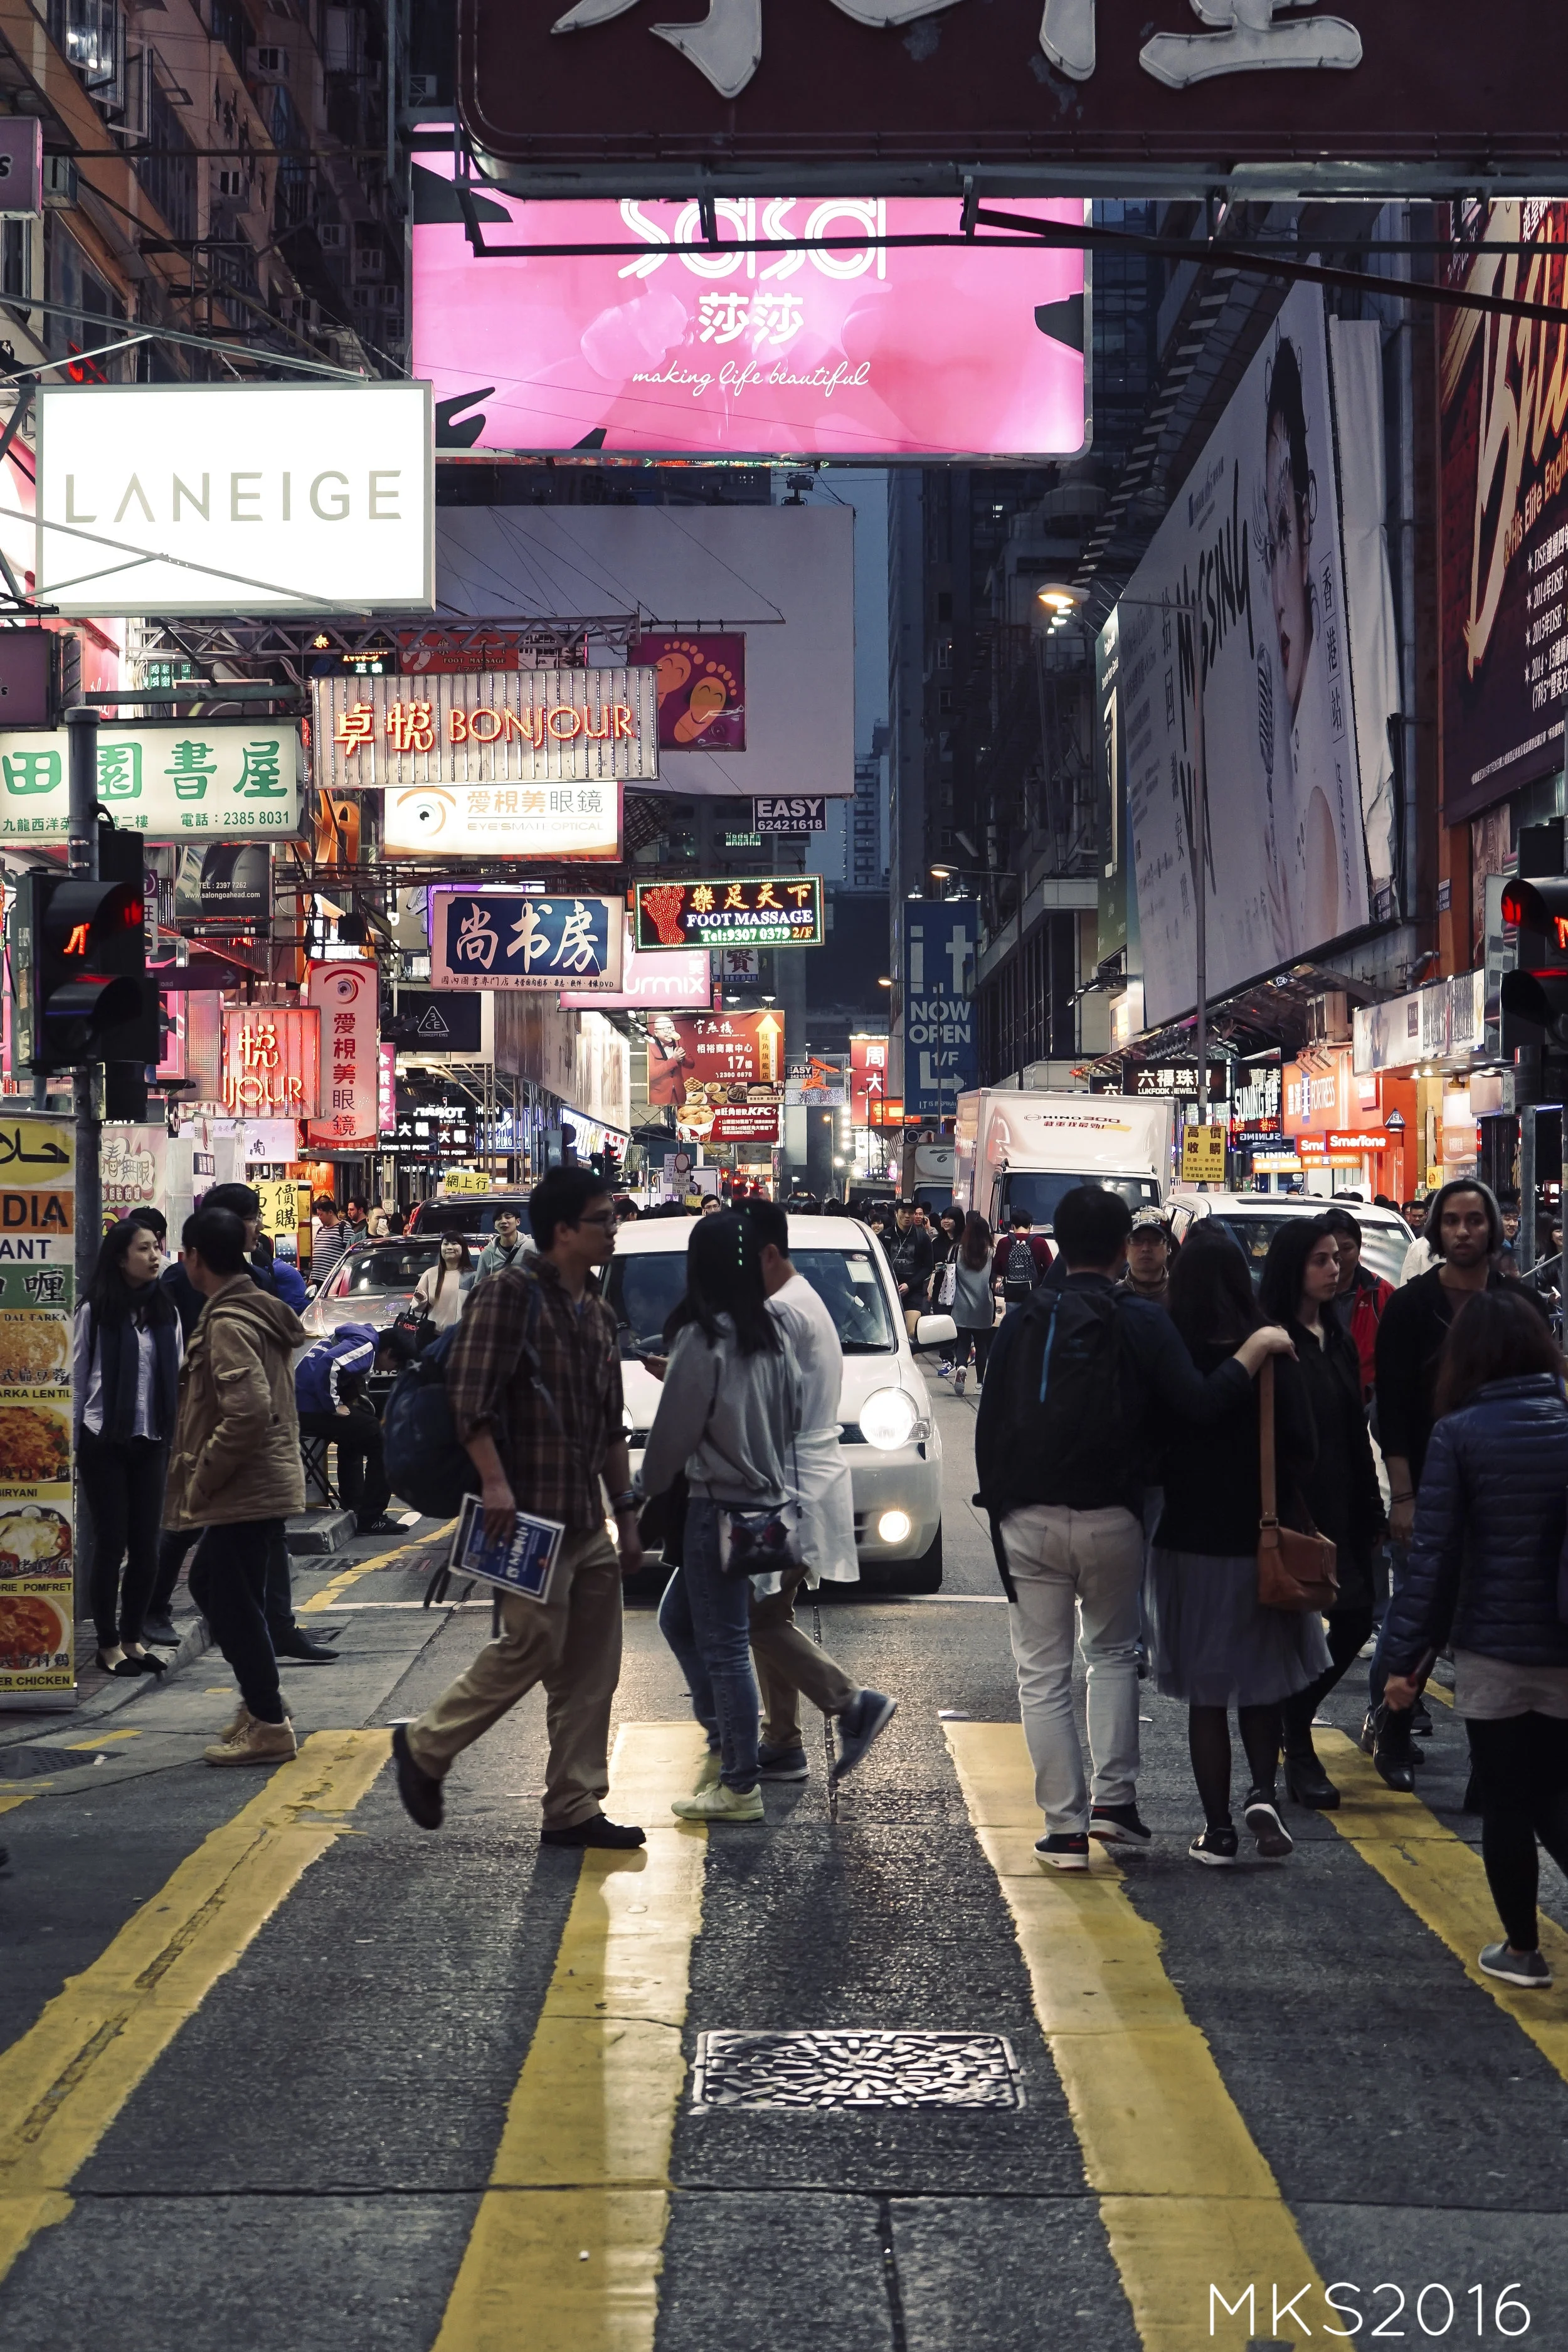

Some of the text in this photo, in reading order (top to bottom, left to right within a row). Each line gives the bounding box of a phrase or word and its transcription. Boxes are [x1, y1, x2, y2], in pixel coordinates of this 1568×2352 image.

[698, 292, 803, 345] 莎莎
[632, 360, 872, 398] making life beautiful
[65, 469, 403, 524] LANEIGE
[1525, 481, 1543, 534] Elite
[1322, 564, 1344, 733] 香港站
[448, 703, 635, 747] BONJOUR
[1, 739, 288, 800] 田園書屋
[467, 790, 603, 813] 愛視美眼鏡
[757, 798, 823, 817] EASY
[758, 819, 823, 830] 62421618
[185, 891, 261, 899] www.salongoahead.com
[690, 882, 812, 913] 樂足天下
[686, 909, 813, 927] FOOT MASSAGE
[760, 927, 791, 940] 0379
[792, 926, 813, 938] 2/F
[910, 1001, 972, 1022] NOW
[909, 1024, 971, 1044] OPEN
[332, 1012, 356, 1136] 愛視美眼鏡
[1234, 1084, 1264, 1121] SUNING
[1311, 1076, 1335, 1110] FORTRESS
[1330, 1135, 1386, 1147] SmarTone
[445, 1172, 489, 1191] 網上行
[23, 1582, 72, 1592] POMFRET
[16, 1676, 70, 1685] CHICKEN
